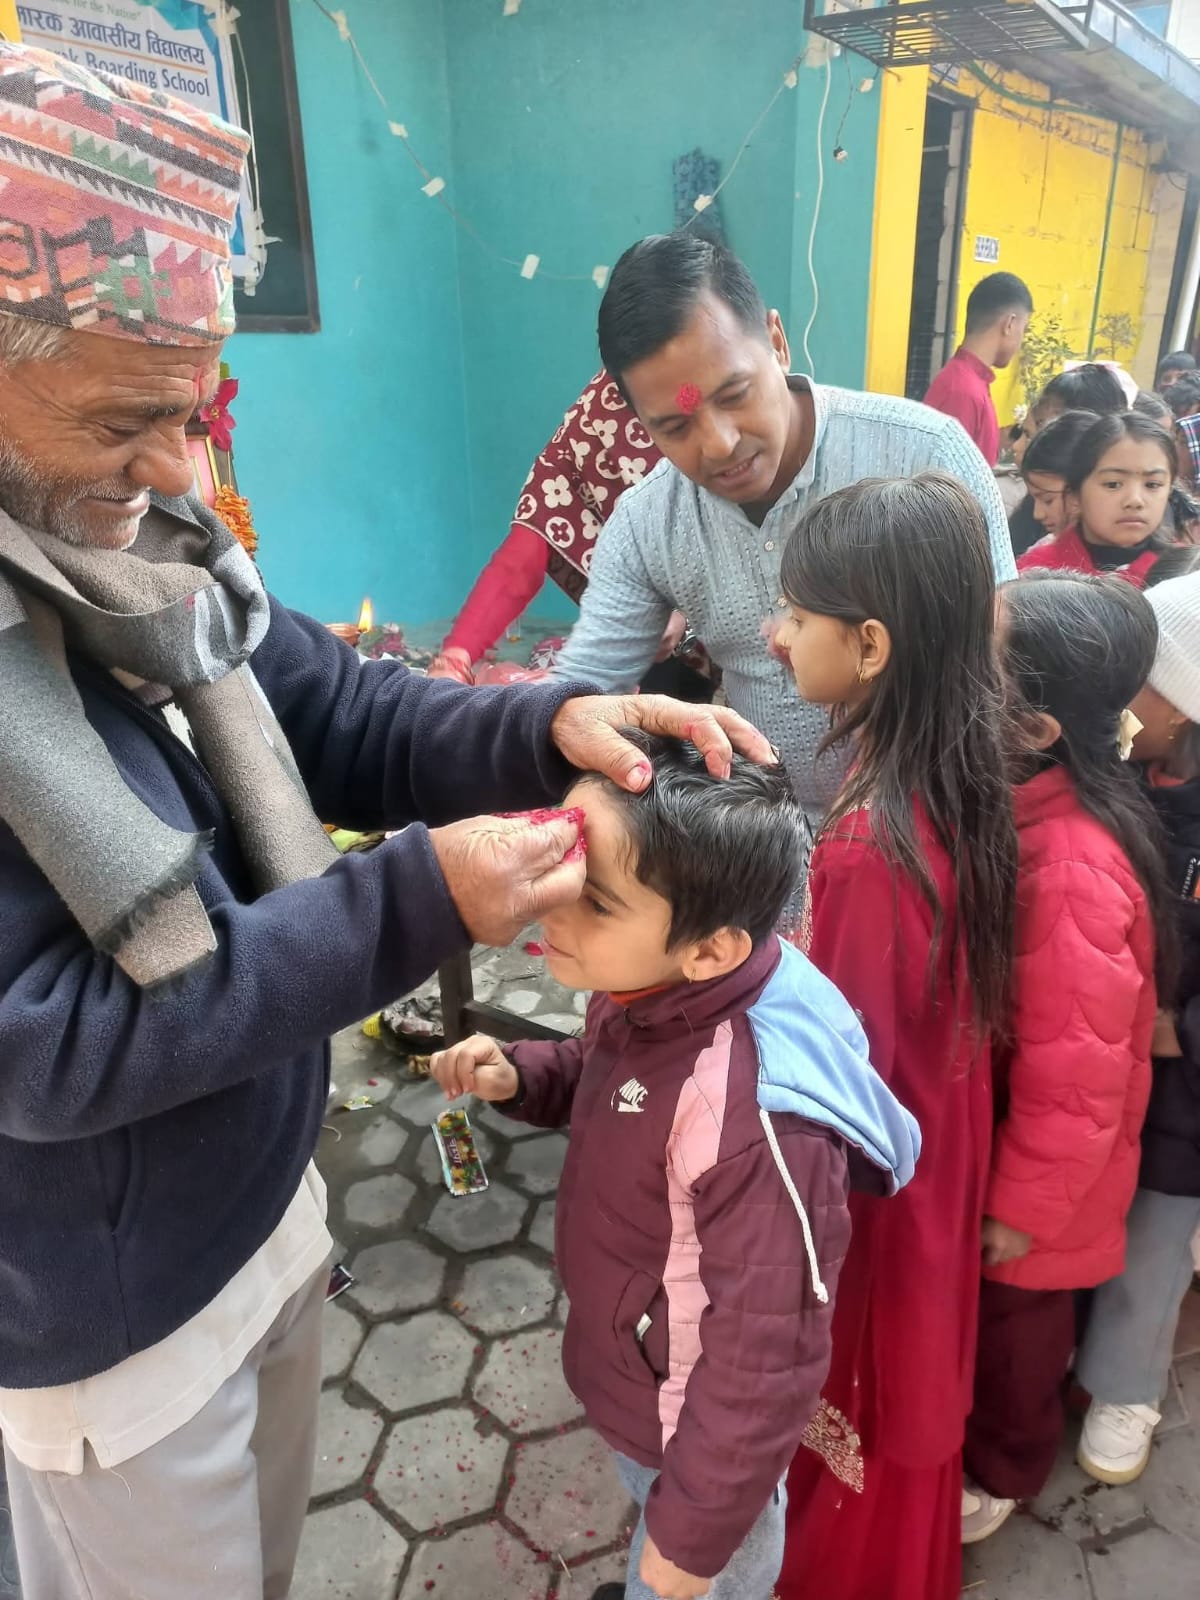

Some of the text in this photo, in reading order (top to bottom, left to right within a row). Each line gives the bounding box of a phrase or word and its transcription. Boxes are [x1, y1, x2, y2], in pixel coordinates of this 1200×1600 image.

[89, 1, 104, 13] the
[68, 17, 141, 50] आवासीय
[145, 30, 205, 65] विद्यालय
[162, 69, 210, 97] School
